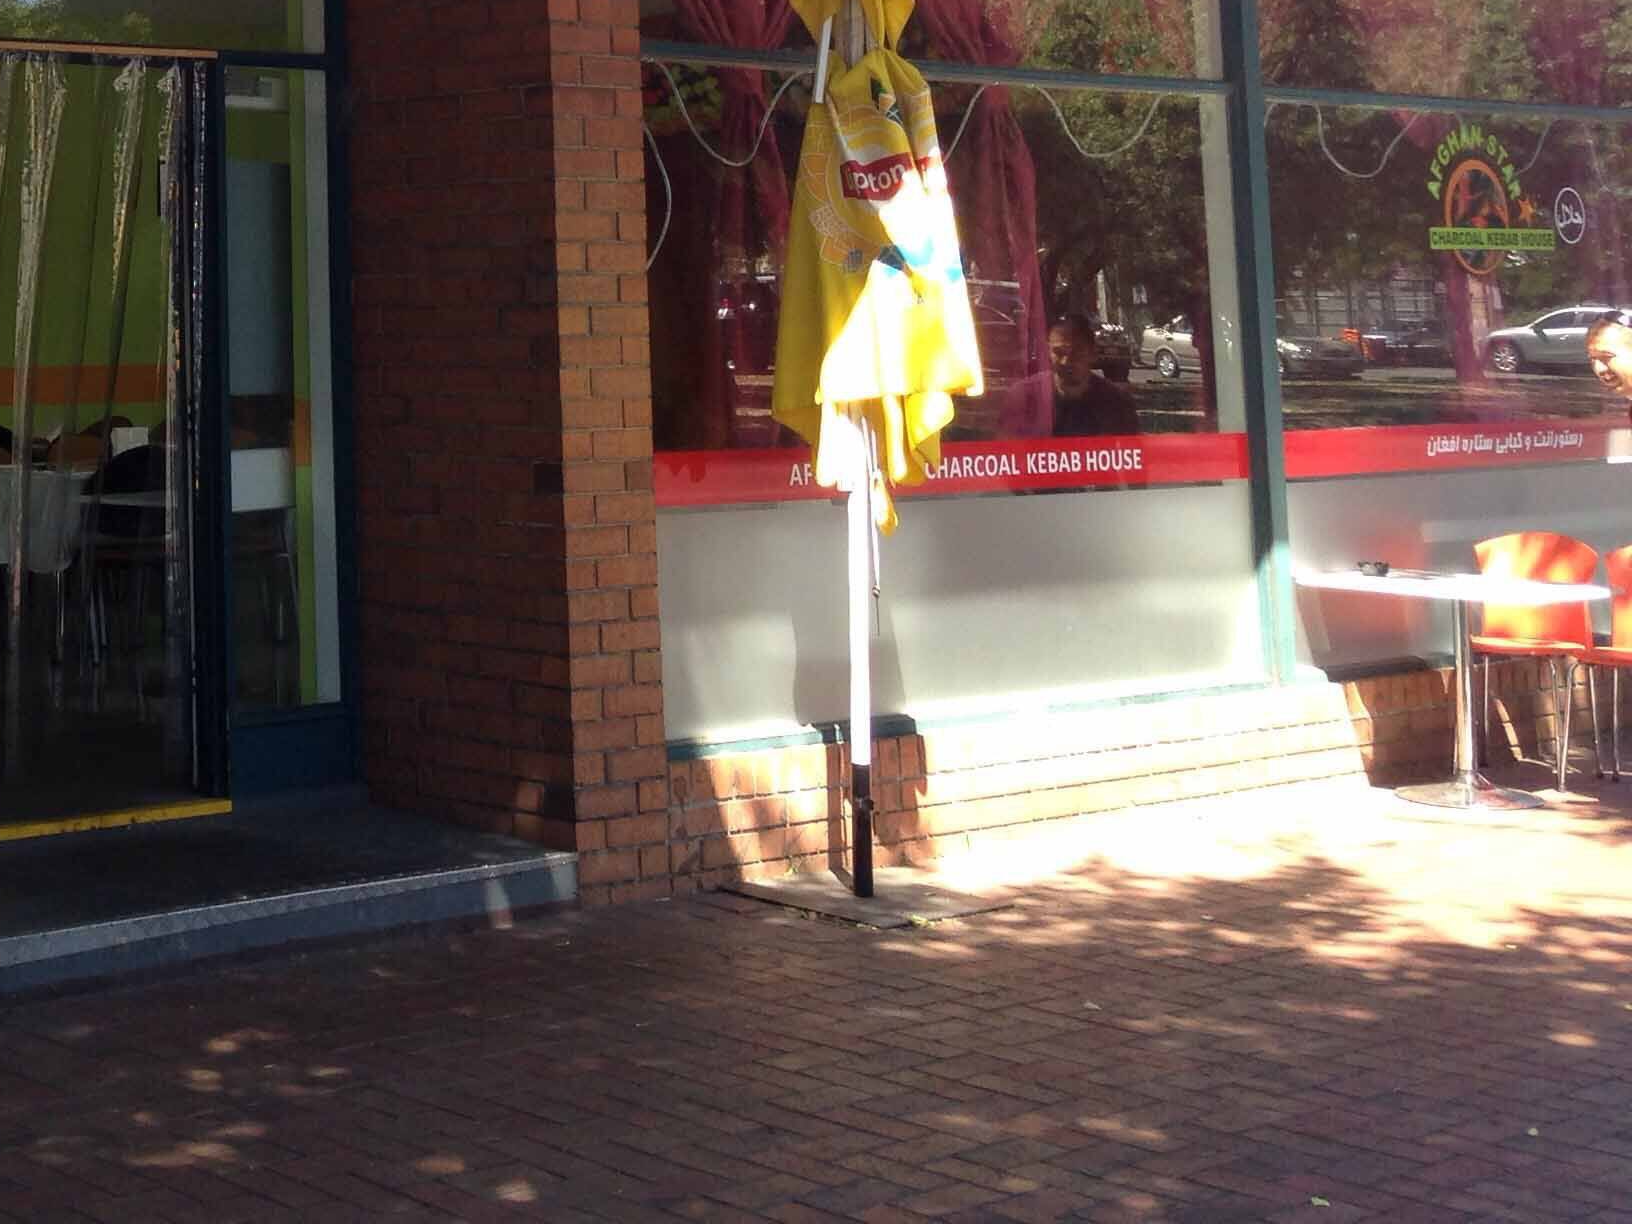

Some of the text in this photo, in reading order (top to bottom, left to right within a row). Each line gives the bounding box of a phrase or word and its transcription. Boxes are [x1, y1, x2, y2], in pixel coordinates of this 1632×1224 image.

[1431, 231, 1554, 247] CHARCOAL KEBAB HOUSE
[1026, 450, 1082, 475] KEBAB
[1086, 448, 1143, 472] HOUSE
